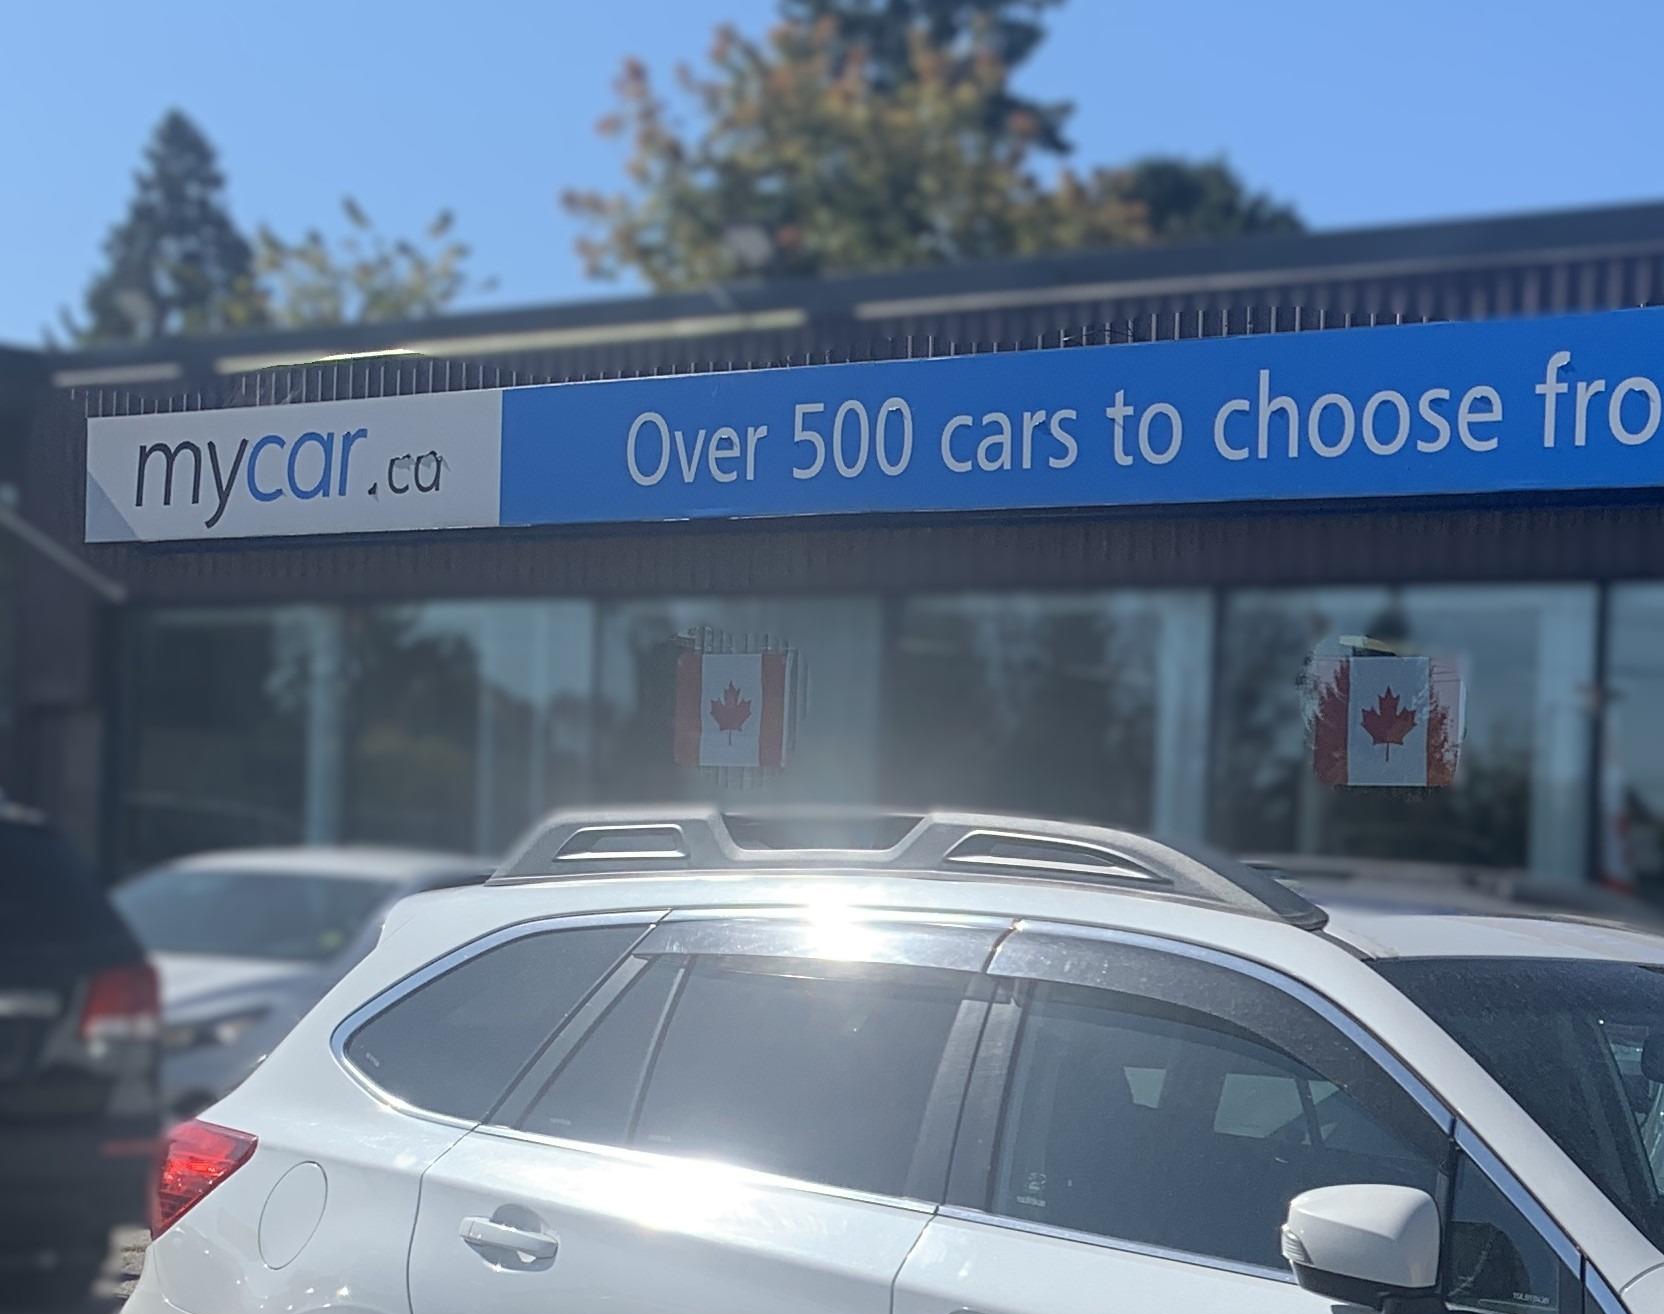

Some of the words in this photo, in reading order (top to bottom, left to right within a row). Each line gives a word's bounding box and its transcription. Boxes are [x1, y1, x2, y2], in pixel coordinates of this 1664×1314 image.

[626, 411, 768, 487] Over
[792, 396, 914, 480] 500
[940, 409, 1079, 473] cars
[1105, 389, 1183, 466] to
[1213, 369, 1503, 461] choose
